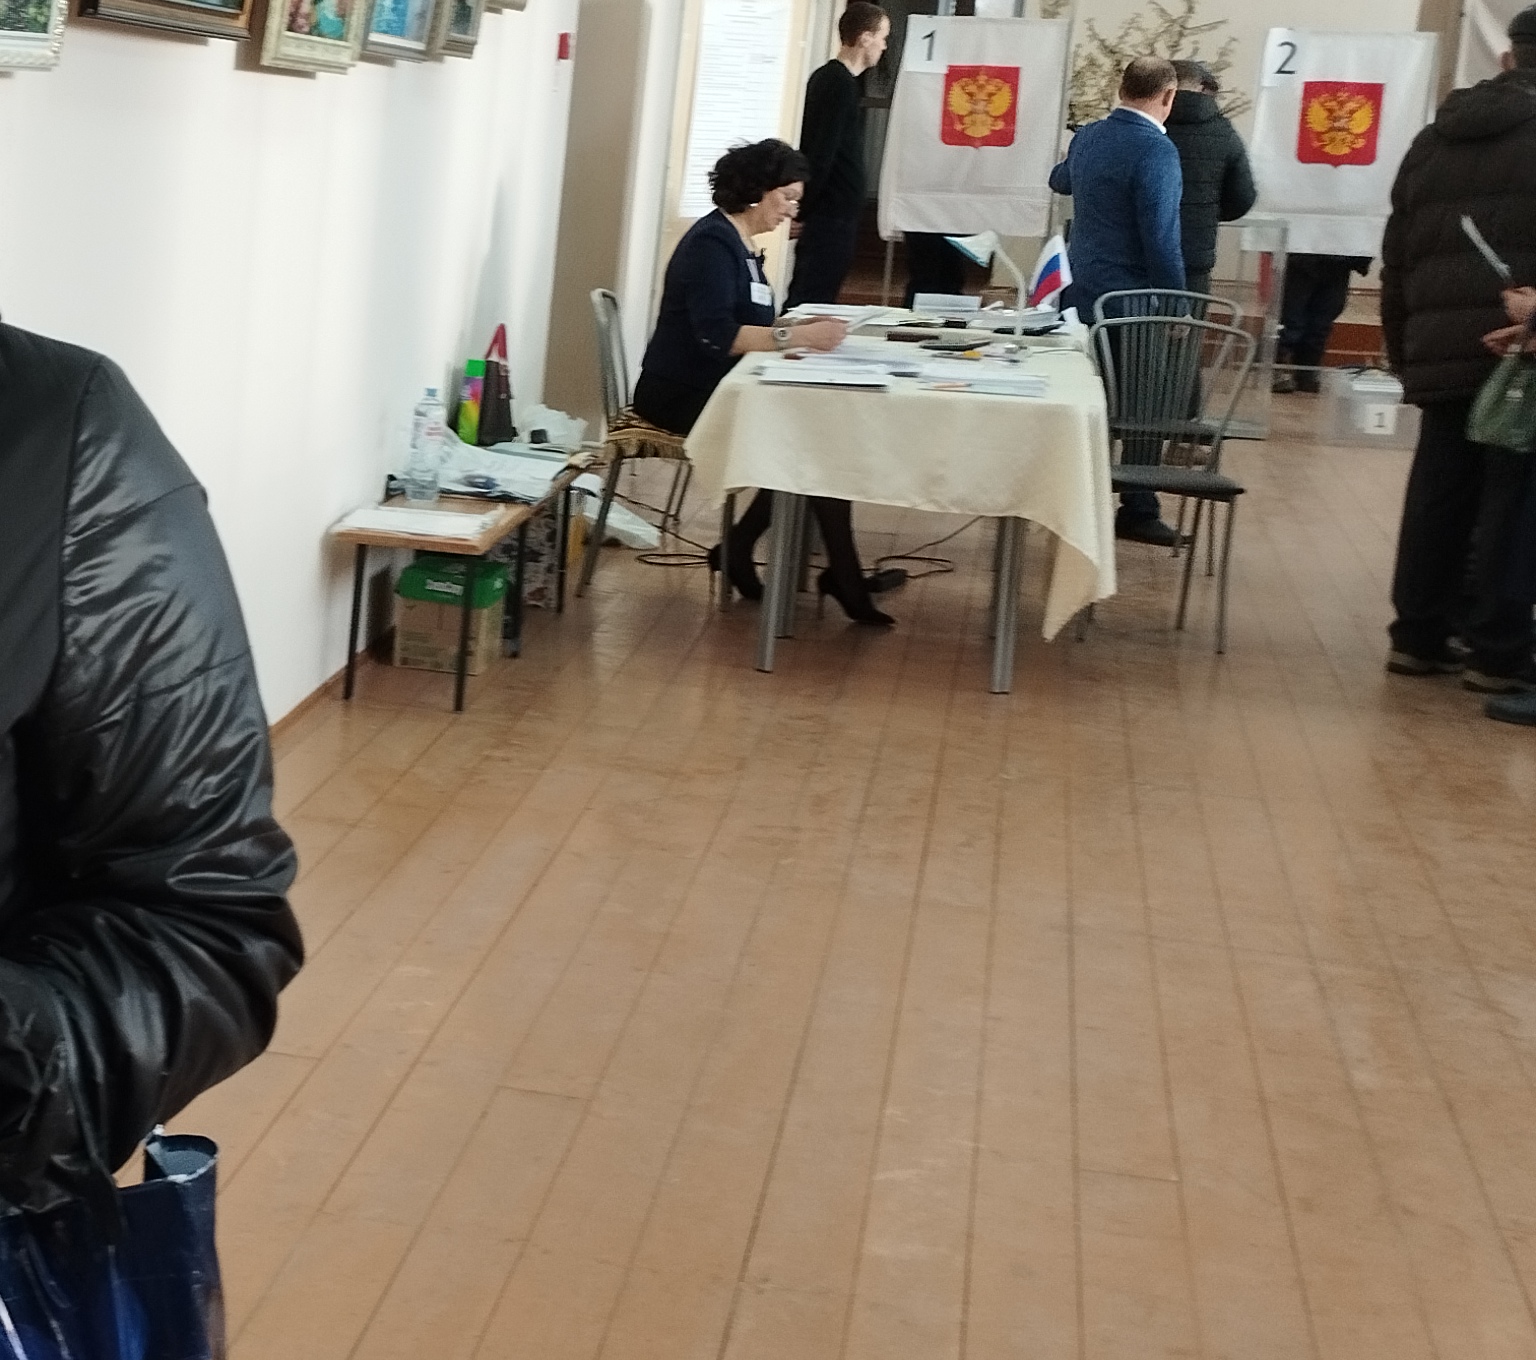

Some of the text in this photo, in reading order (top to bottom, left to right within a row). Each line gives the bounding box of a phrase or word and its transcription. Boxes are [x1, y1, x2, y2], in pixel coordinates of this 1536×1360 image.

[922, 29, 936, 61] 1
[1274, 41, 1297, 74] 2
[1374, 412, 1385, 428] 1
